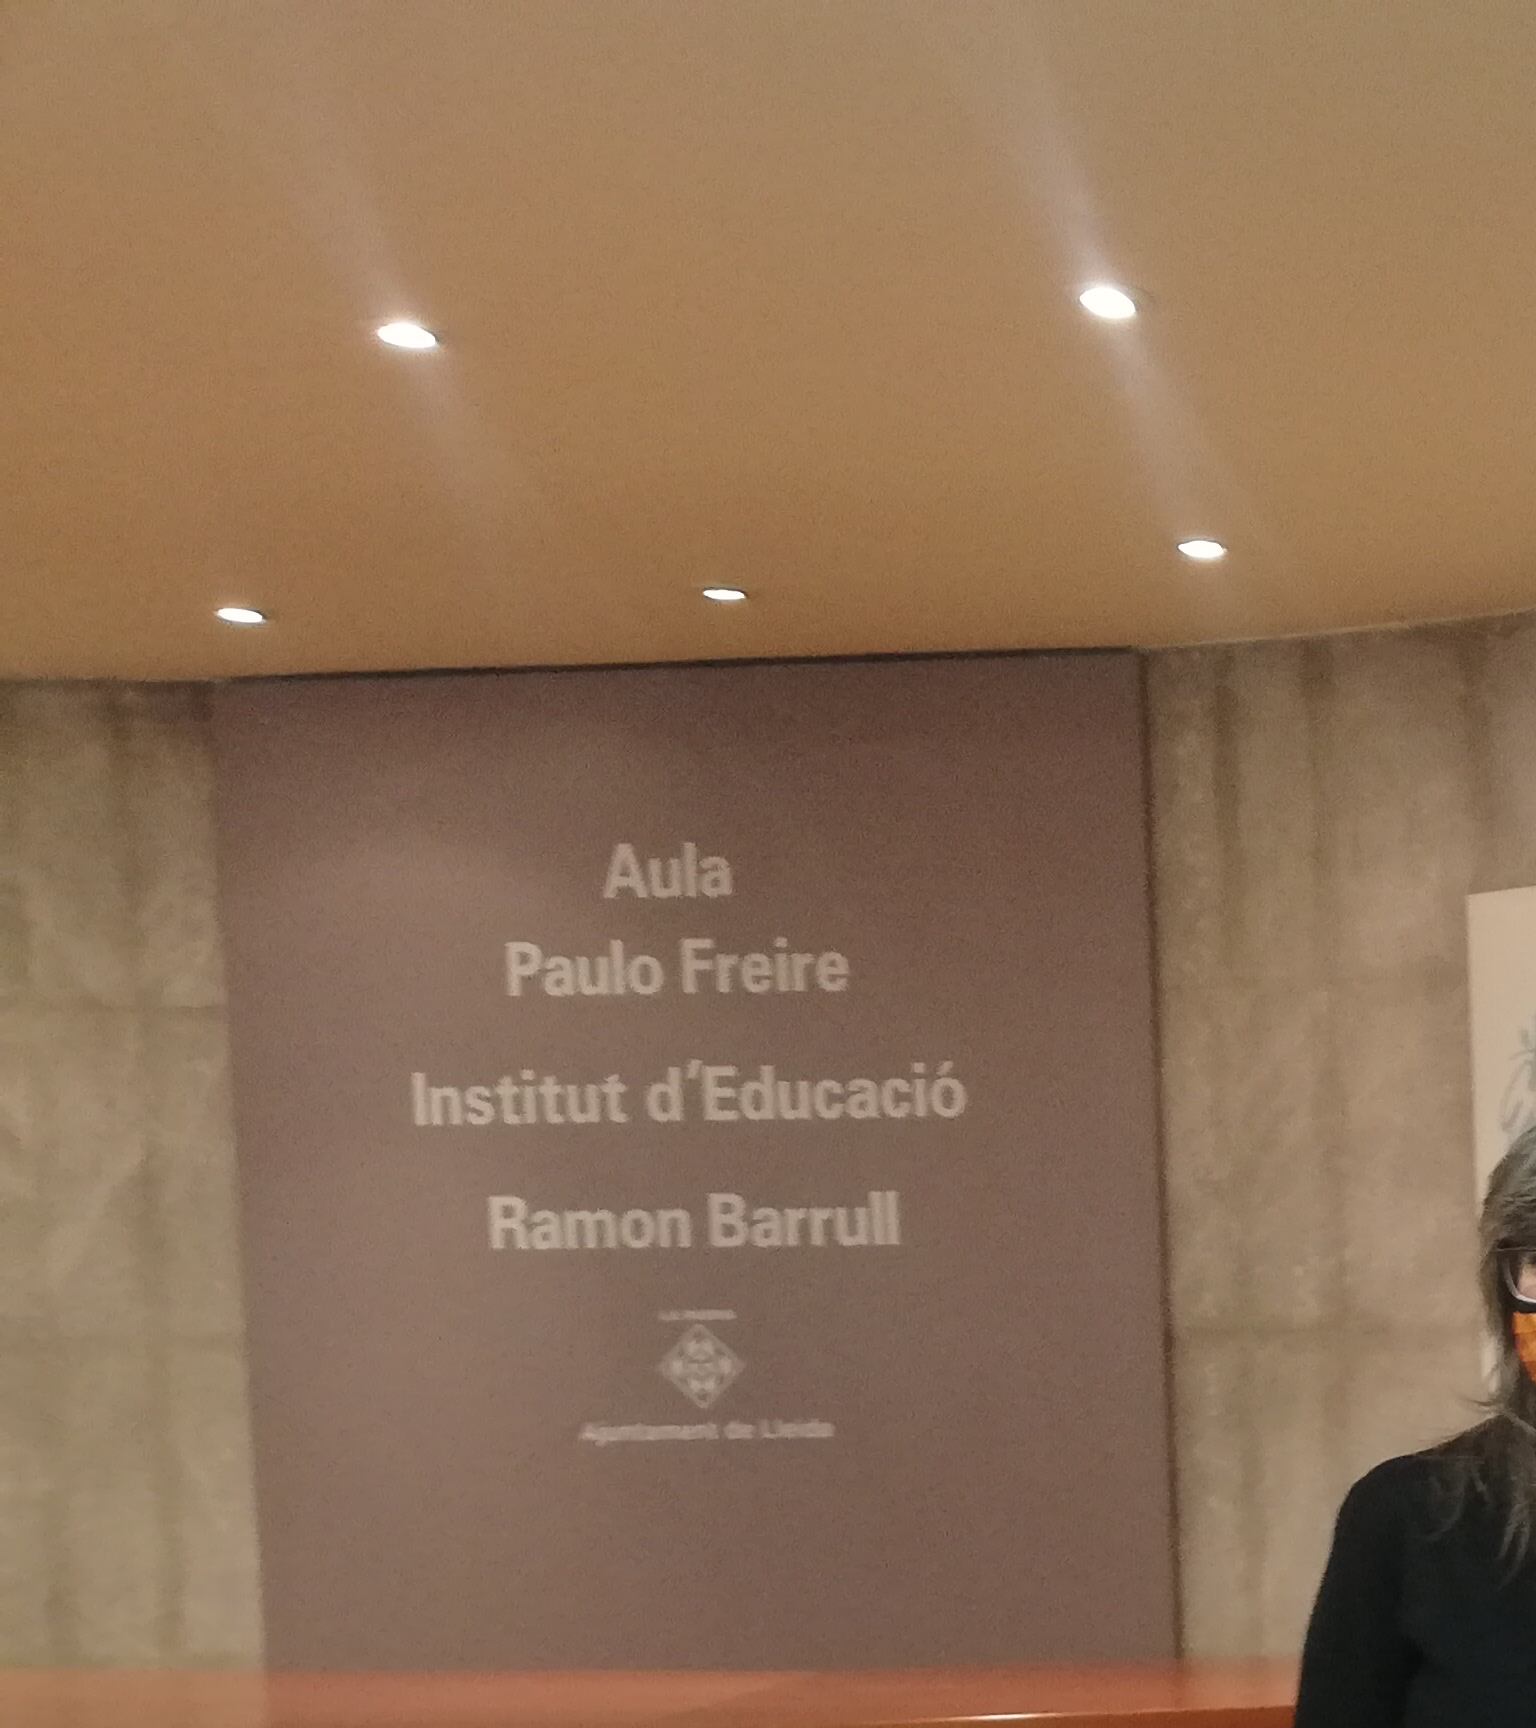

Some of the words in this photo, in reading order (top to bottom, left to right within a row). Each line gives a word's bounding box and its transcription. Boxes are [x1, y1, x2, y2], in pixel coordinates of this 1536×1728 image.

[602, 842, 732, 899] Aula
[505, 940, 663, 997] Paulo
[680, 937, 849, 995] Freire
[411, 1069, 628, 1126] Institut
[645, 1059, 967, 1123] d'Educació
[487, 1195, 691, 1250] Ramon
[708, 1190, 900, 1248] Barrull
